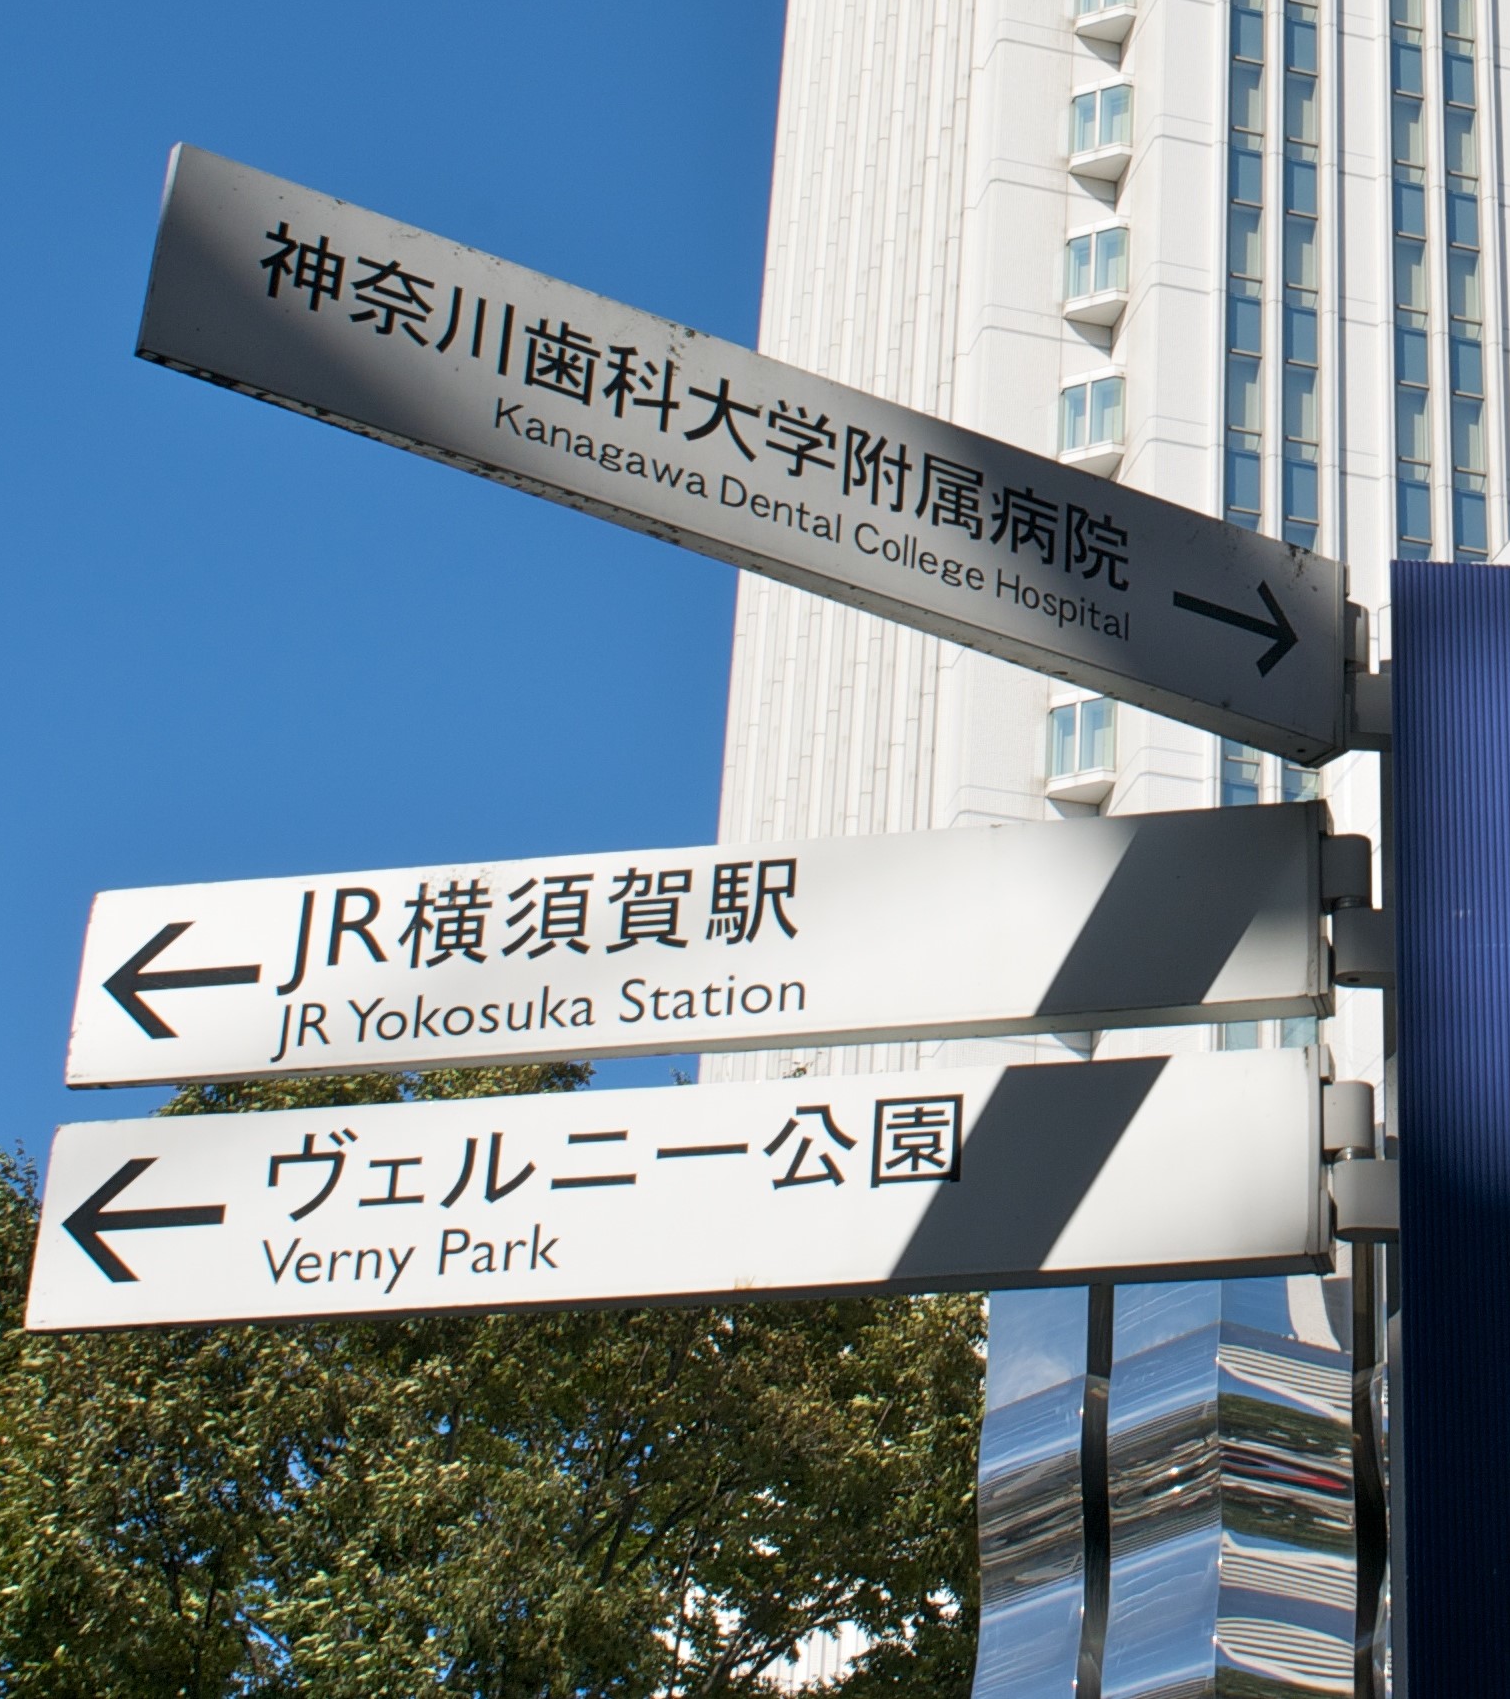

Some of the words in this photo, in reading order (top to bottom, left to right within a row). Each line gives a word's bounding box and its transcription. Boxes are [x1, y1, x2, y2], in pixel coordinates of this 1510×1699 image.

[260, 222, 1130, 592] 神奈川歯科大学附属病院
[494, 397, 709, 499] Kanagawa
[720, 474, 842, 544] Dental
[854, 522, 985, 591] College
[996, 568, 1130, 642] Hospital
[275, 857, 798, 997] JR横須賀駅
[270, 1002, 331, 1064] JR
[348, 985, 595, 1043] Yokosuka
[619, 978, 805, 1023] Station
[265, 1093, 964, 1222] ヴェルニー公園
[262, 1237, 416, 1294] Verny
[438, 1223, 559, 1276] Park
